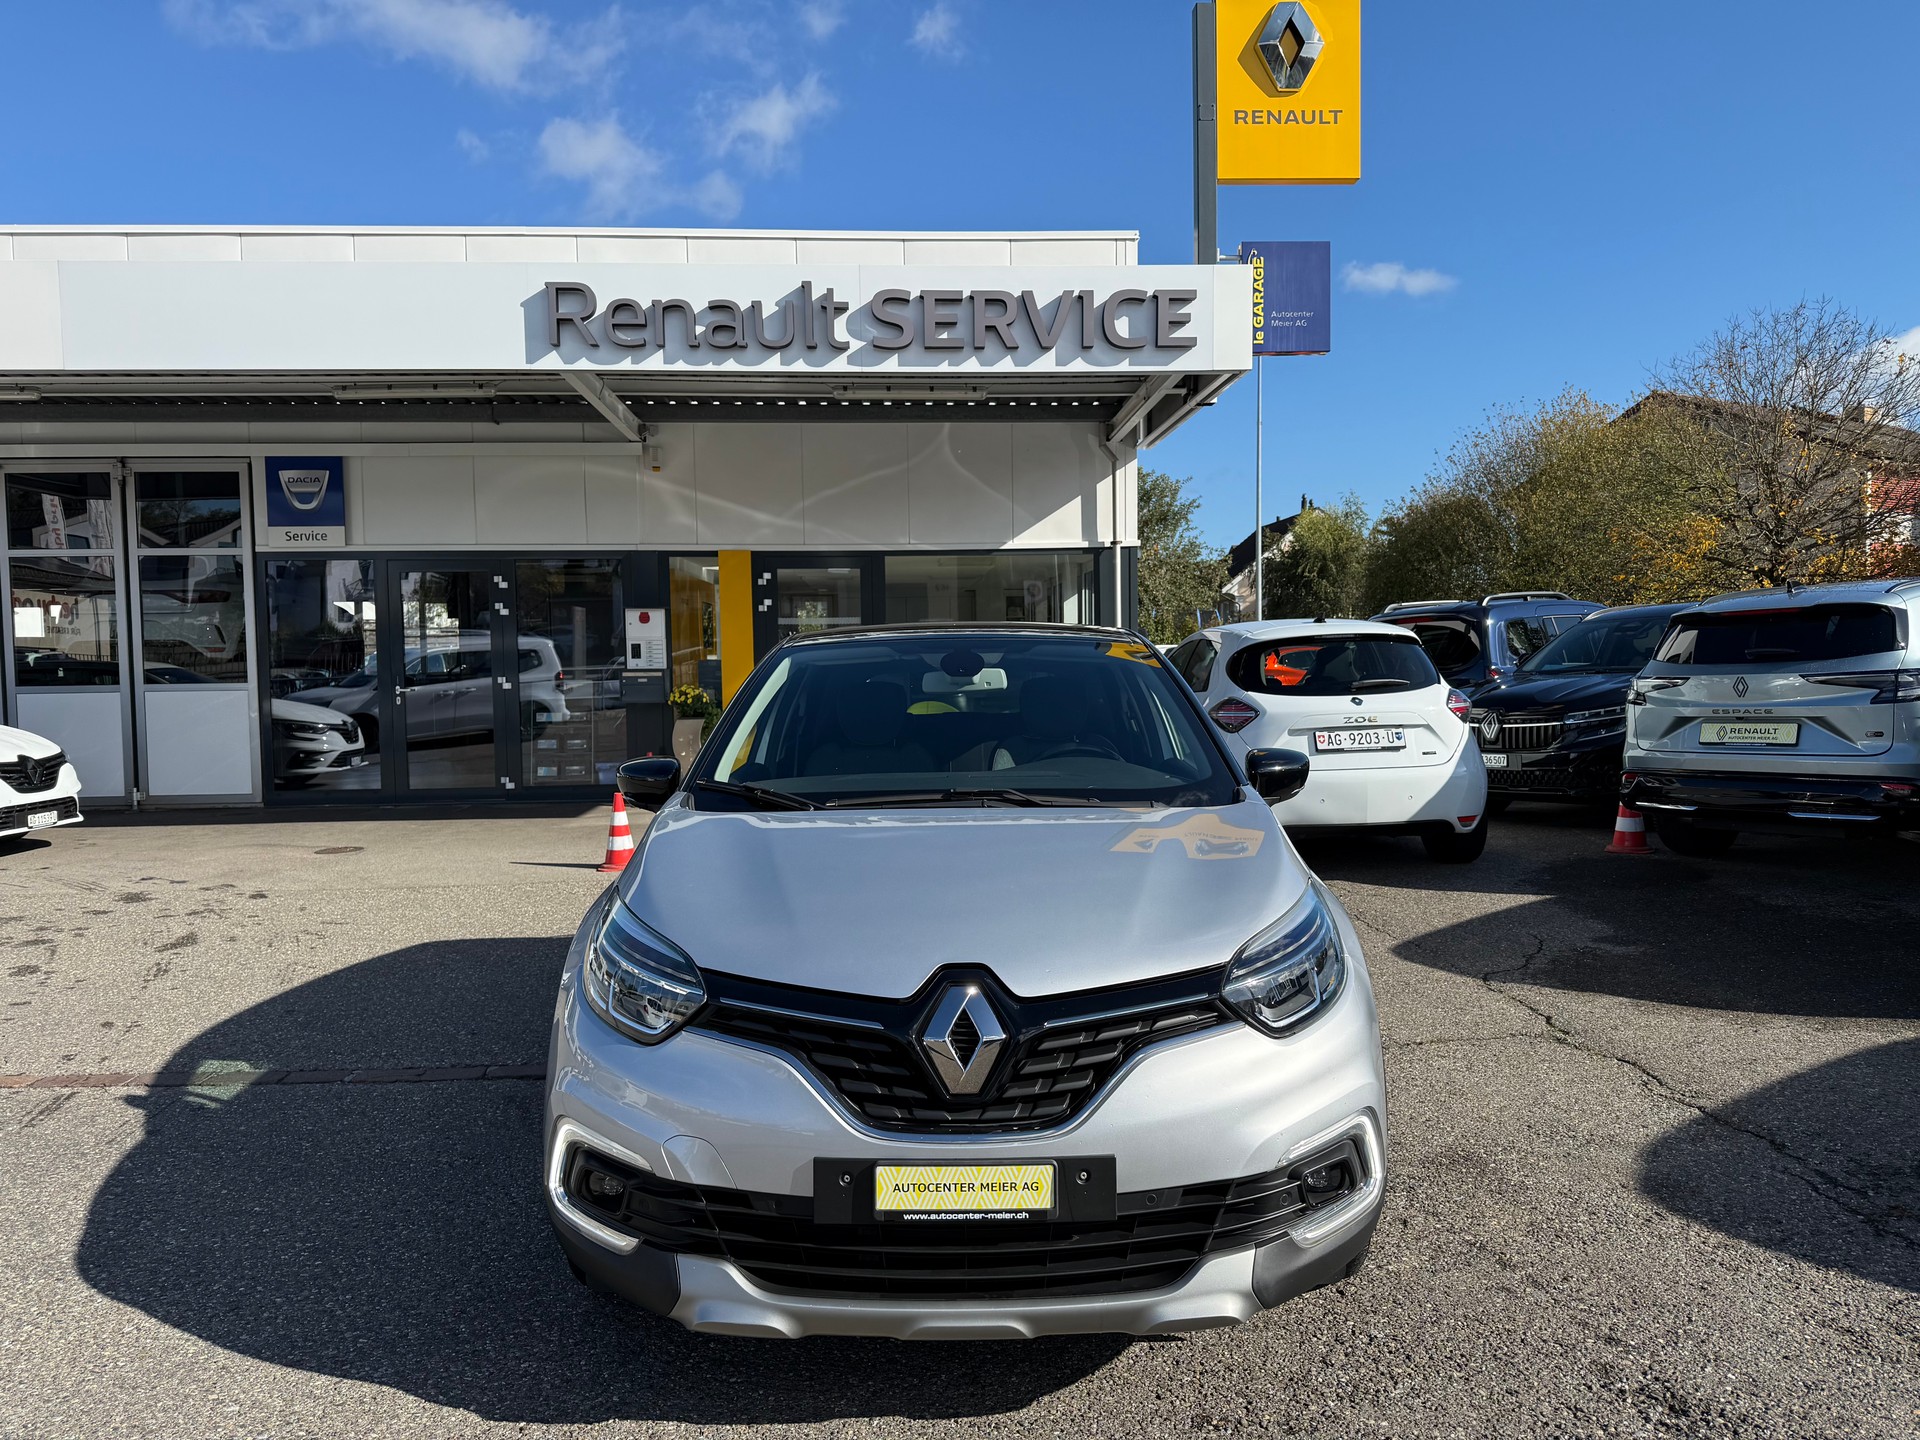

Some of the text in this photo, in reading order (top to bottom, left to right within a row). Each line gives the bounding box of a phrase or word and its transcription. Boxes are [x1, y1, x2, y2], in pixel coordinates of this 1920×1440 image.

[1233, 109, 1344, 125] RENAULT
[1253, 256, 1265, 345] le GARAGE
[545, 281, 1199, 351] Renault SERVICE
[1271, 310, 1315, 319] Autocenter
[1271, 319, 1308, 327] Meier AG
[287, 476, 321, 484] DACIA
[285, 530, 328, 542] Service
[1343, 716, 1378, 724] ZOE
[1729, 727, 1779, 735] RENAULT
[892, 1181, 1040, 1193] AUTOCENTER MEIER AG
[903, 1211, 1030, 1221] www.autocenter-meier.ch
